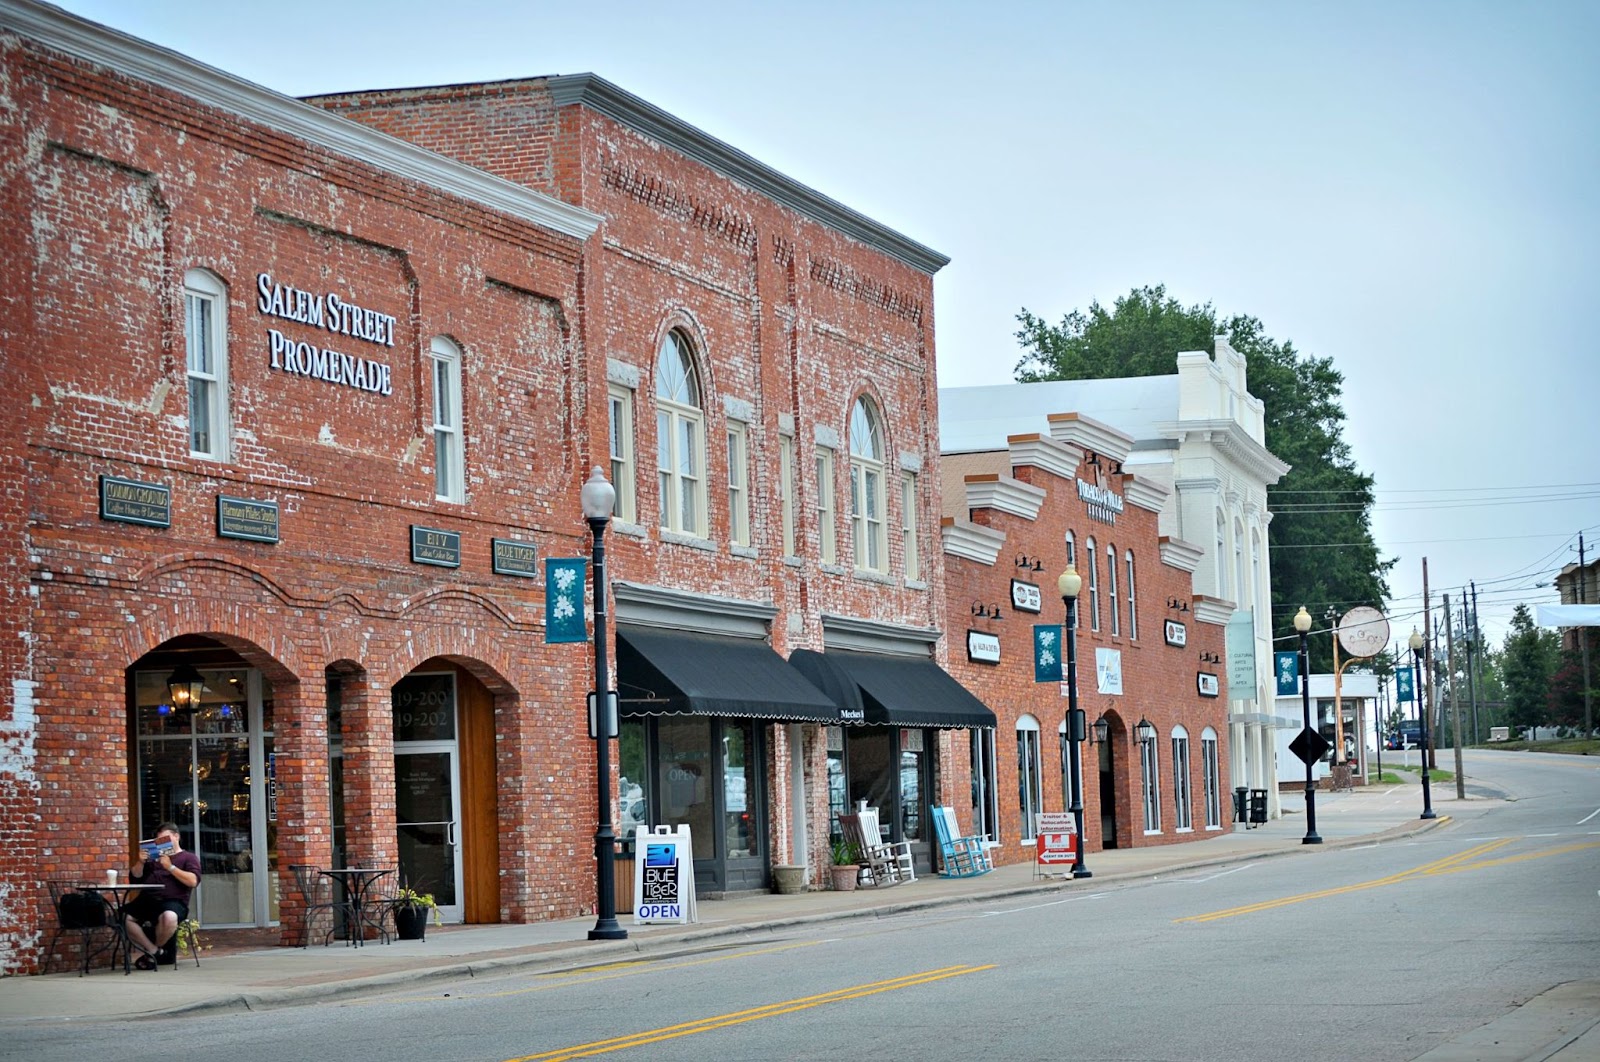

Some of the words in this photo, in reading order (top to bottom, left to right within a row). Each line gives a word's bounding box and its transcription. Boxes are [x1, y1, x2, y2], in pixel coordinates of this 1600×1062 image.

[257, 273, 325, 329] SALEM
[326, 292, 396, 348] STREET
[267, 328, 392, 396] PROMENADE
[107, 483, 136, 501] COMMON
[136, 488, 167, 507] GROUNDS
[497, 544, 514, 559] BLUE
[514, 547, 534, 561] TIGER
[639, 905, 680, 918] OPEN
